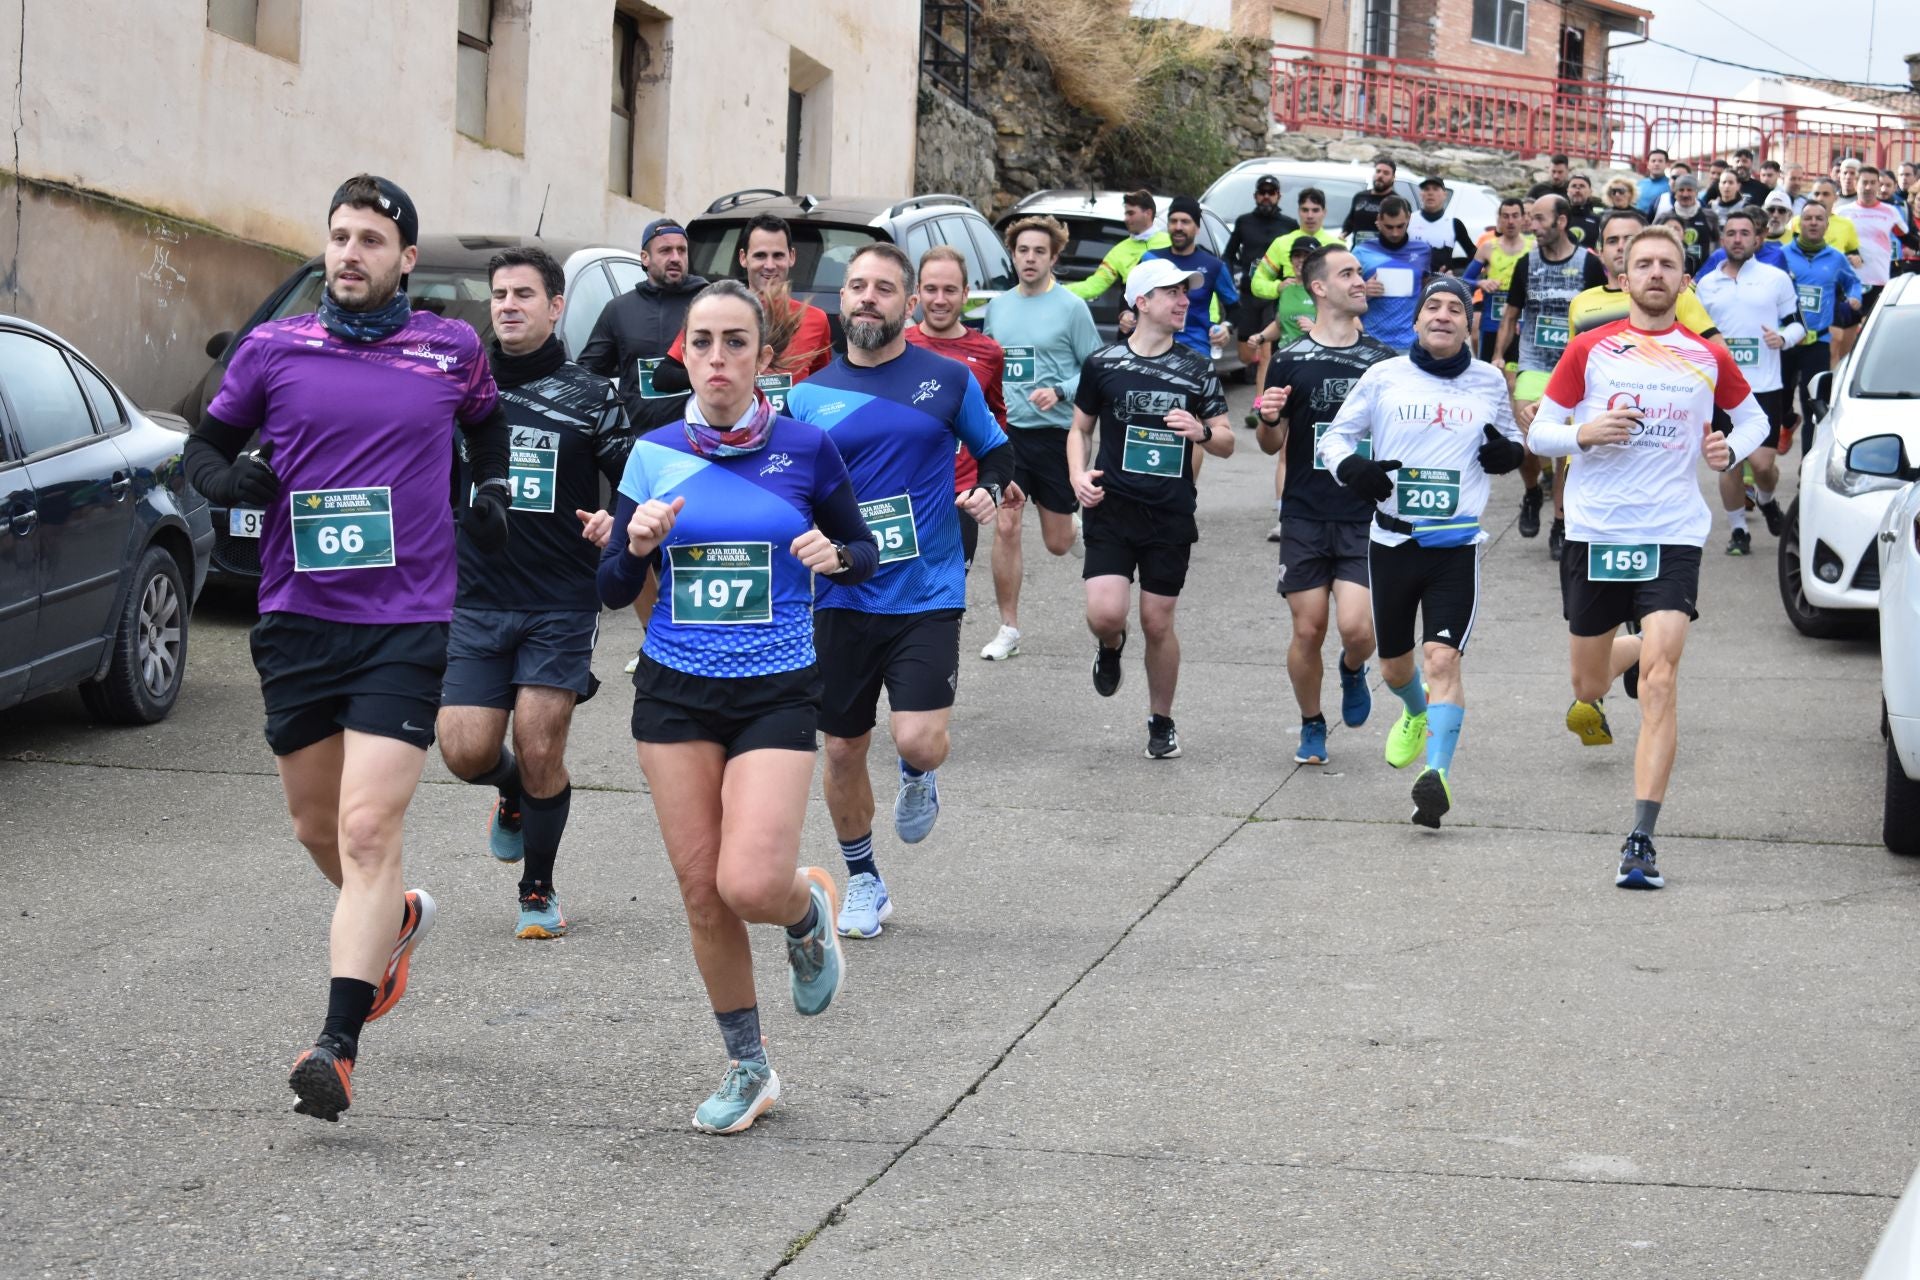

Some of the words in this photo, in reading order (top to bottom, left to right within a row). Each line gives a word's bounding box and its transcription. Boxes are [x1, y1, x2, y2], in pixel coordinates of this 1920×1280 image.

[1542, 330, 1569, 343] 144
[1005, 363, 1023, 377] 70
[1609, 380, 1644, 390] Agencia
[1660, 384, 1695, 394] Seguros
[1146, 449, 1161, 467] 3
[336, 500, 371, 508] NAVARRA
[1406, 489, 1450, 509] 203
[317, 525, 364, 554] 66
[1601, 550, 1648, 571] 159
[688, 579, 753, 608] 197
